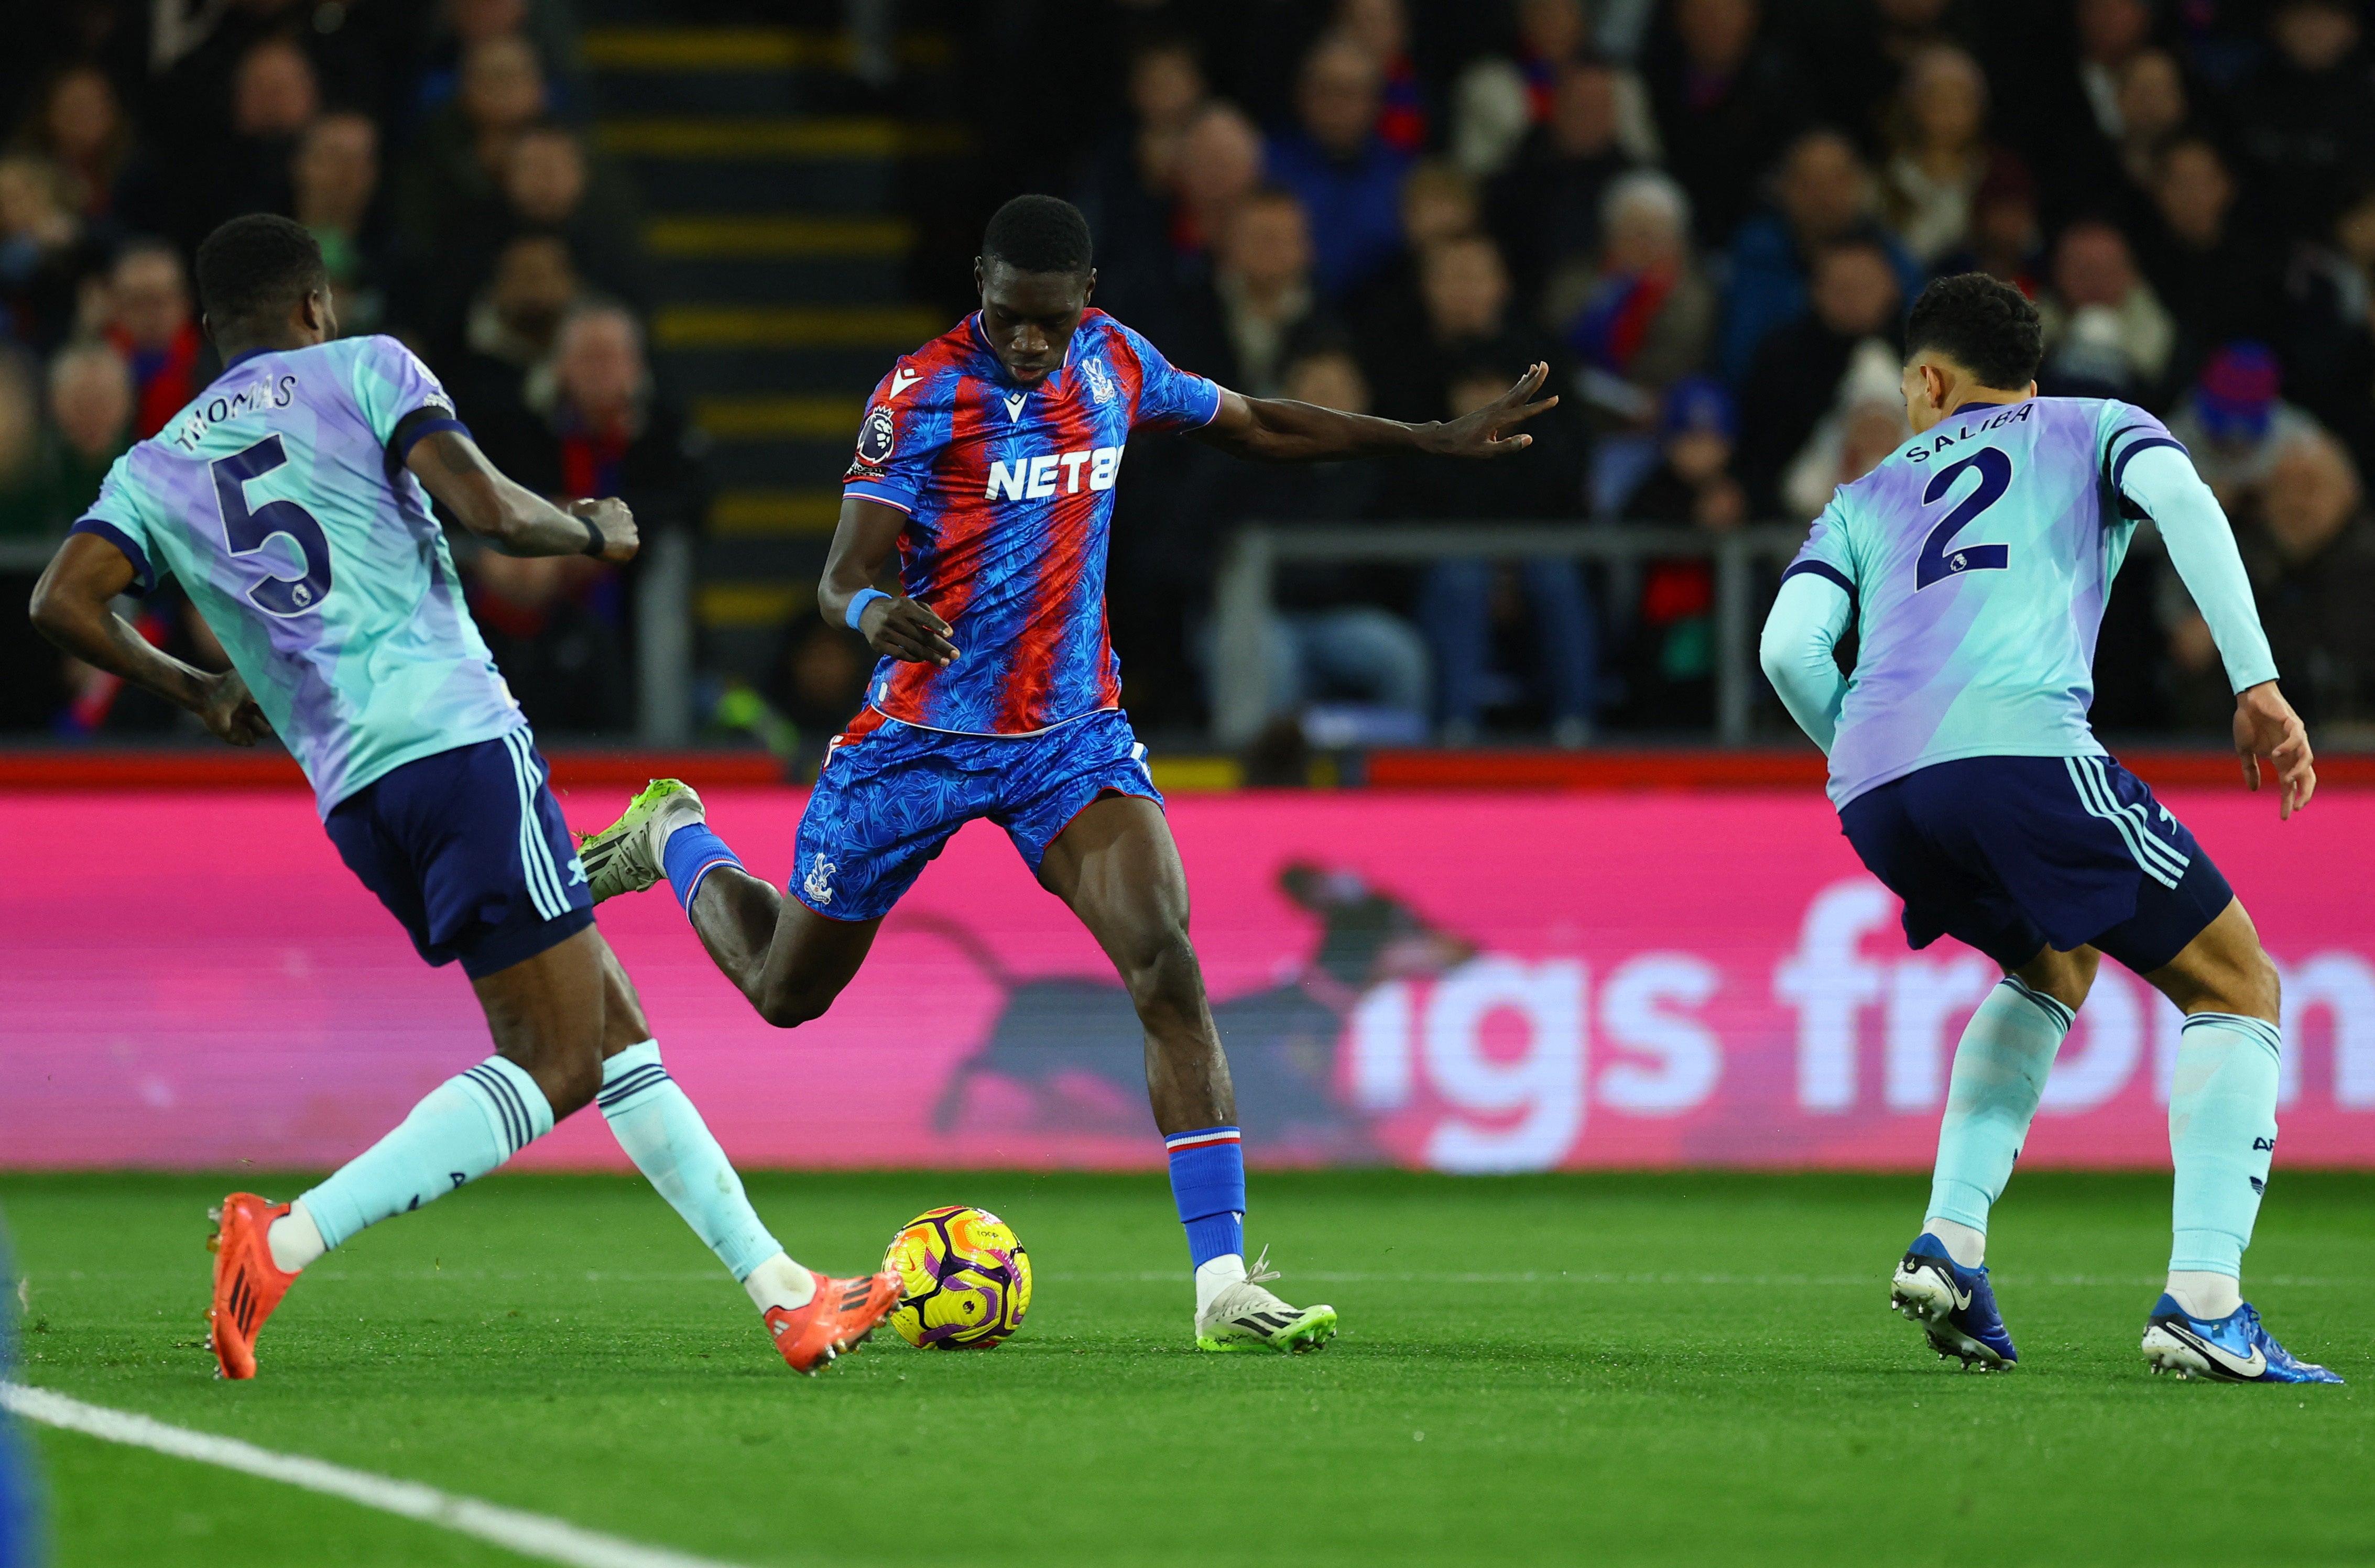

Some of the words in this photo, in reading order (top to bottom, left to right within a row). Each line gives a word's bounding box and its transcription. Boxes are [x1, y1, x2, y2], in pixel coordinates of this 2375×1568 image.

[173, 374, 298, 453] THOMAS
[1906, 402, 2034, 464] SALIBA
[208, 432, 333, 618] 5
[1914, 445, 2012, 594] 2
